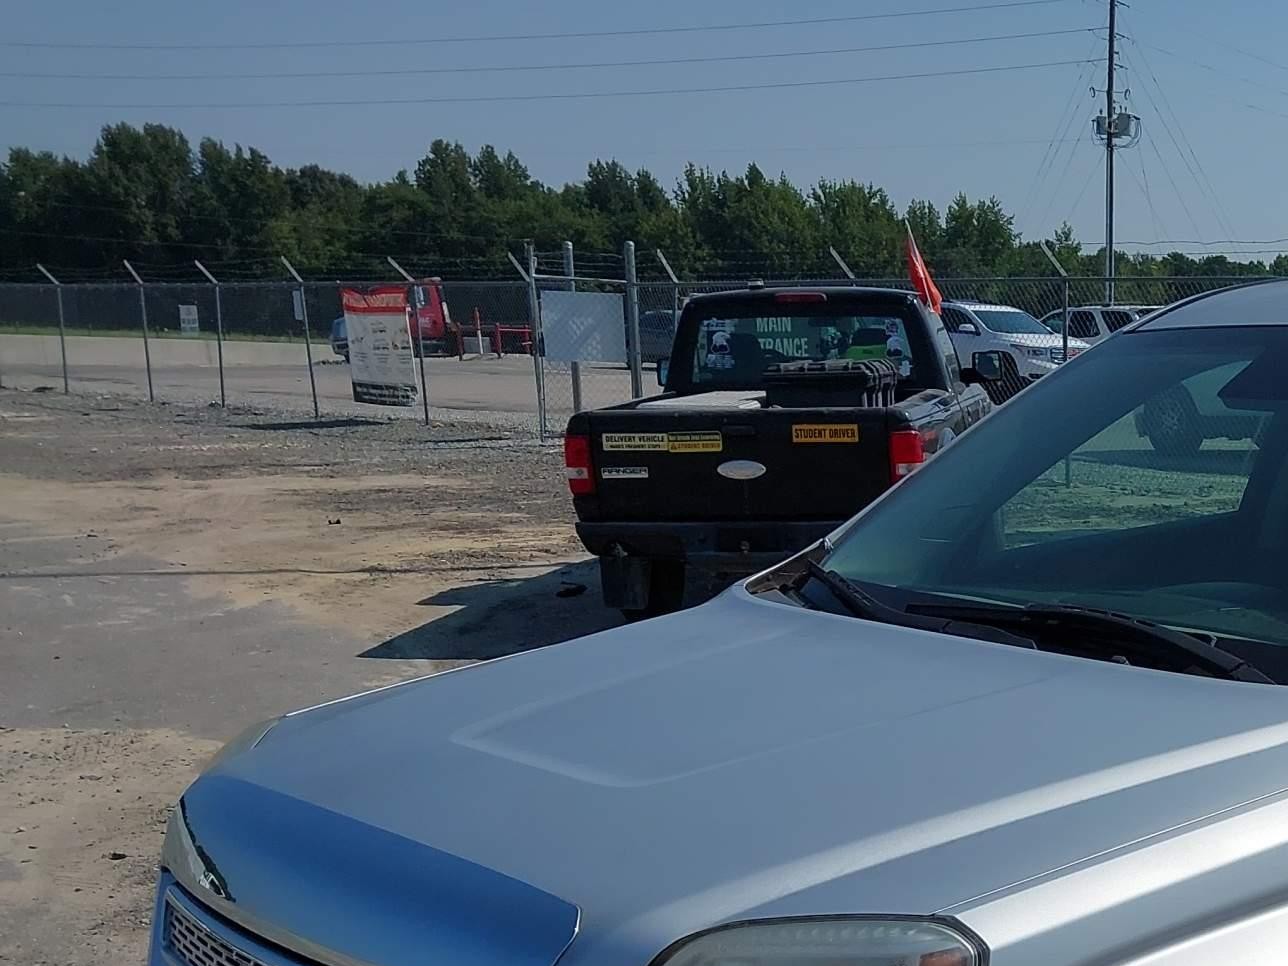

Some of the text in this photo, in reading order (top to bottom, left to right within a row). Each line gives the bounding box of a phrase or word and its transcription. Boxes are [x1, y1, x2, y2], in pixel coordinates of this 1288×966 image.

[756, 317, 792, 333] MAIN
[757, 337, 809, 357] TRANCE
[604, 435, 636, 443] DELIVERY
[638, 435, 665, 443] VEHICLE
[794, 428, 856, 439] STUDENT DRIVER
[602, 467, 648, 476] RANGER
